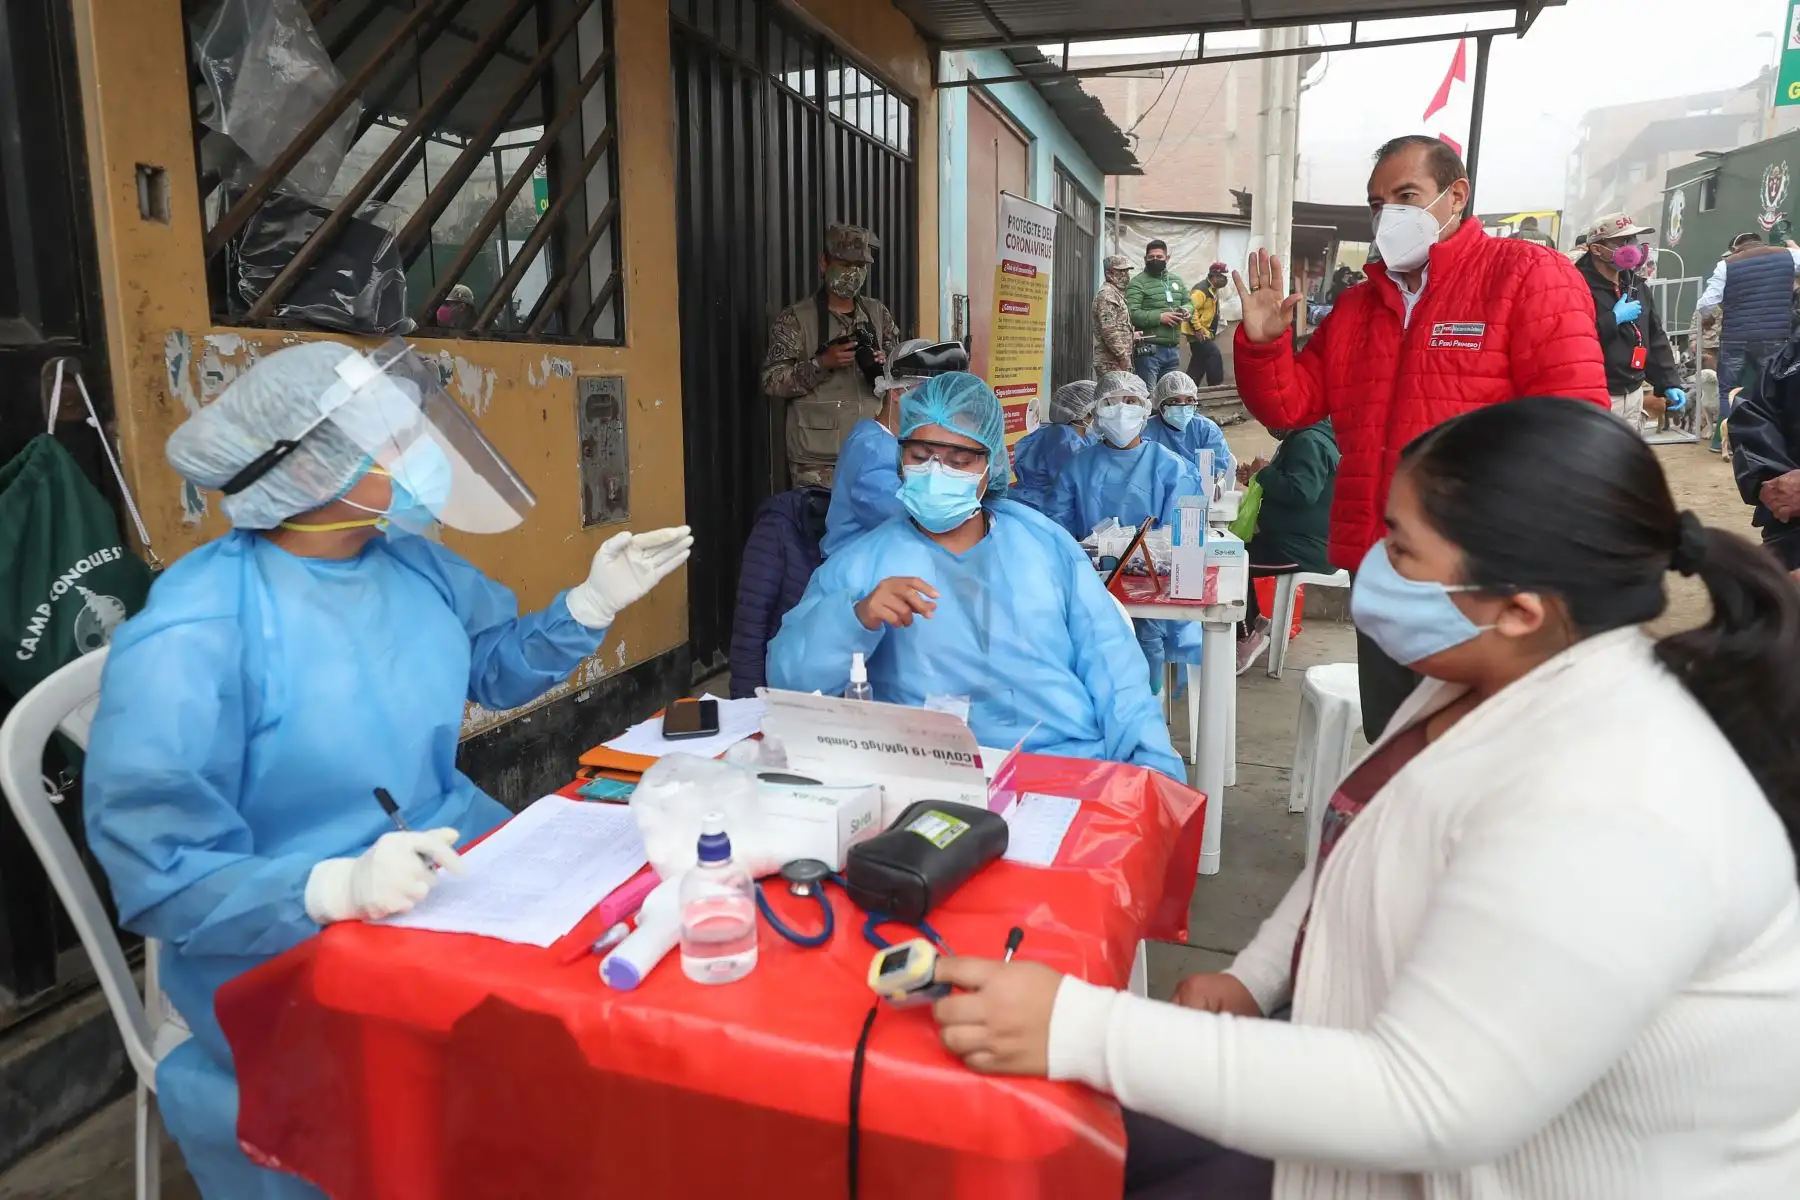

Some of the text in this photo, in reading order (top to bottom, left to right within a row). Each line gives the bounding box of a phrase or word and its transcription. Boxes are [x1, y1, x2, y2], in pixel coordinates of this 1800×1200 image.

[1005, 232, 1052, 259] CORONAVIRUS
[1042, 226, 1053, 241] DEL
[16, 603, 52, 660] CAMP
[816, 735, 972, 763] COVID-19 IgM/IgG Combo
